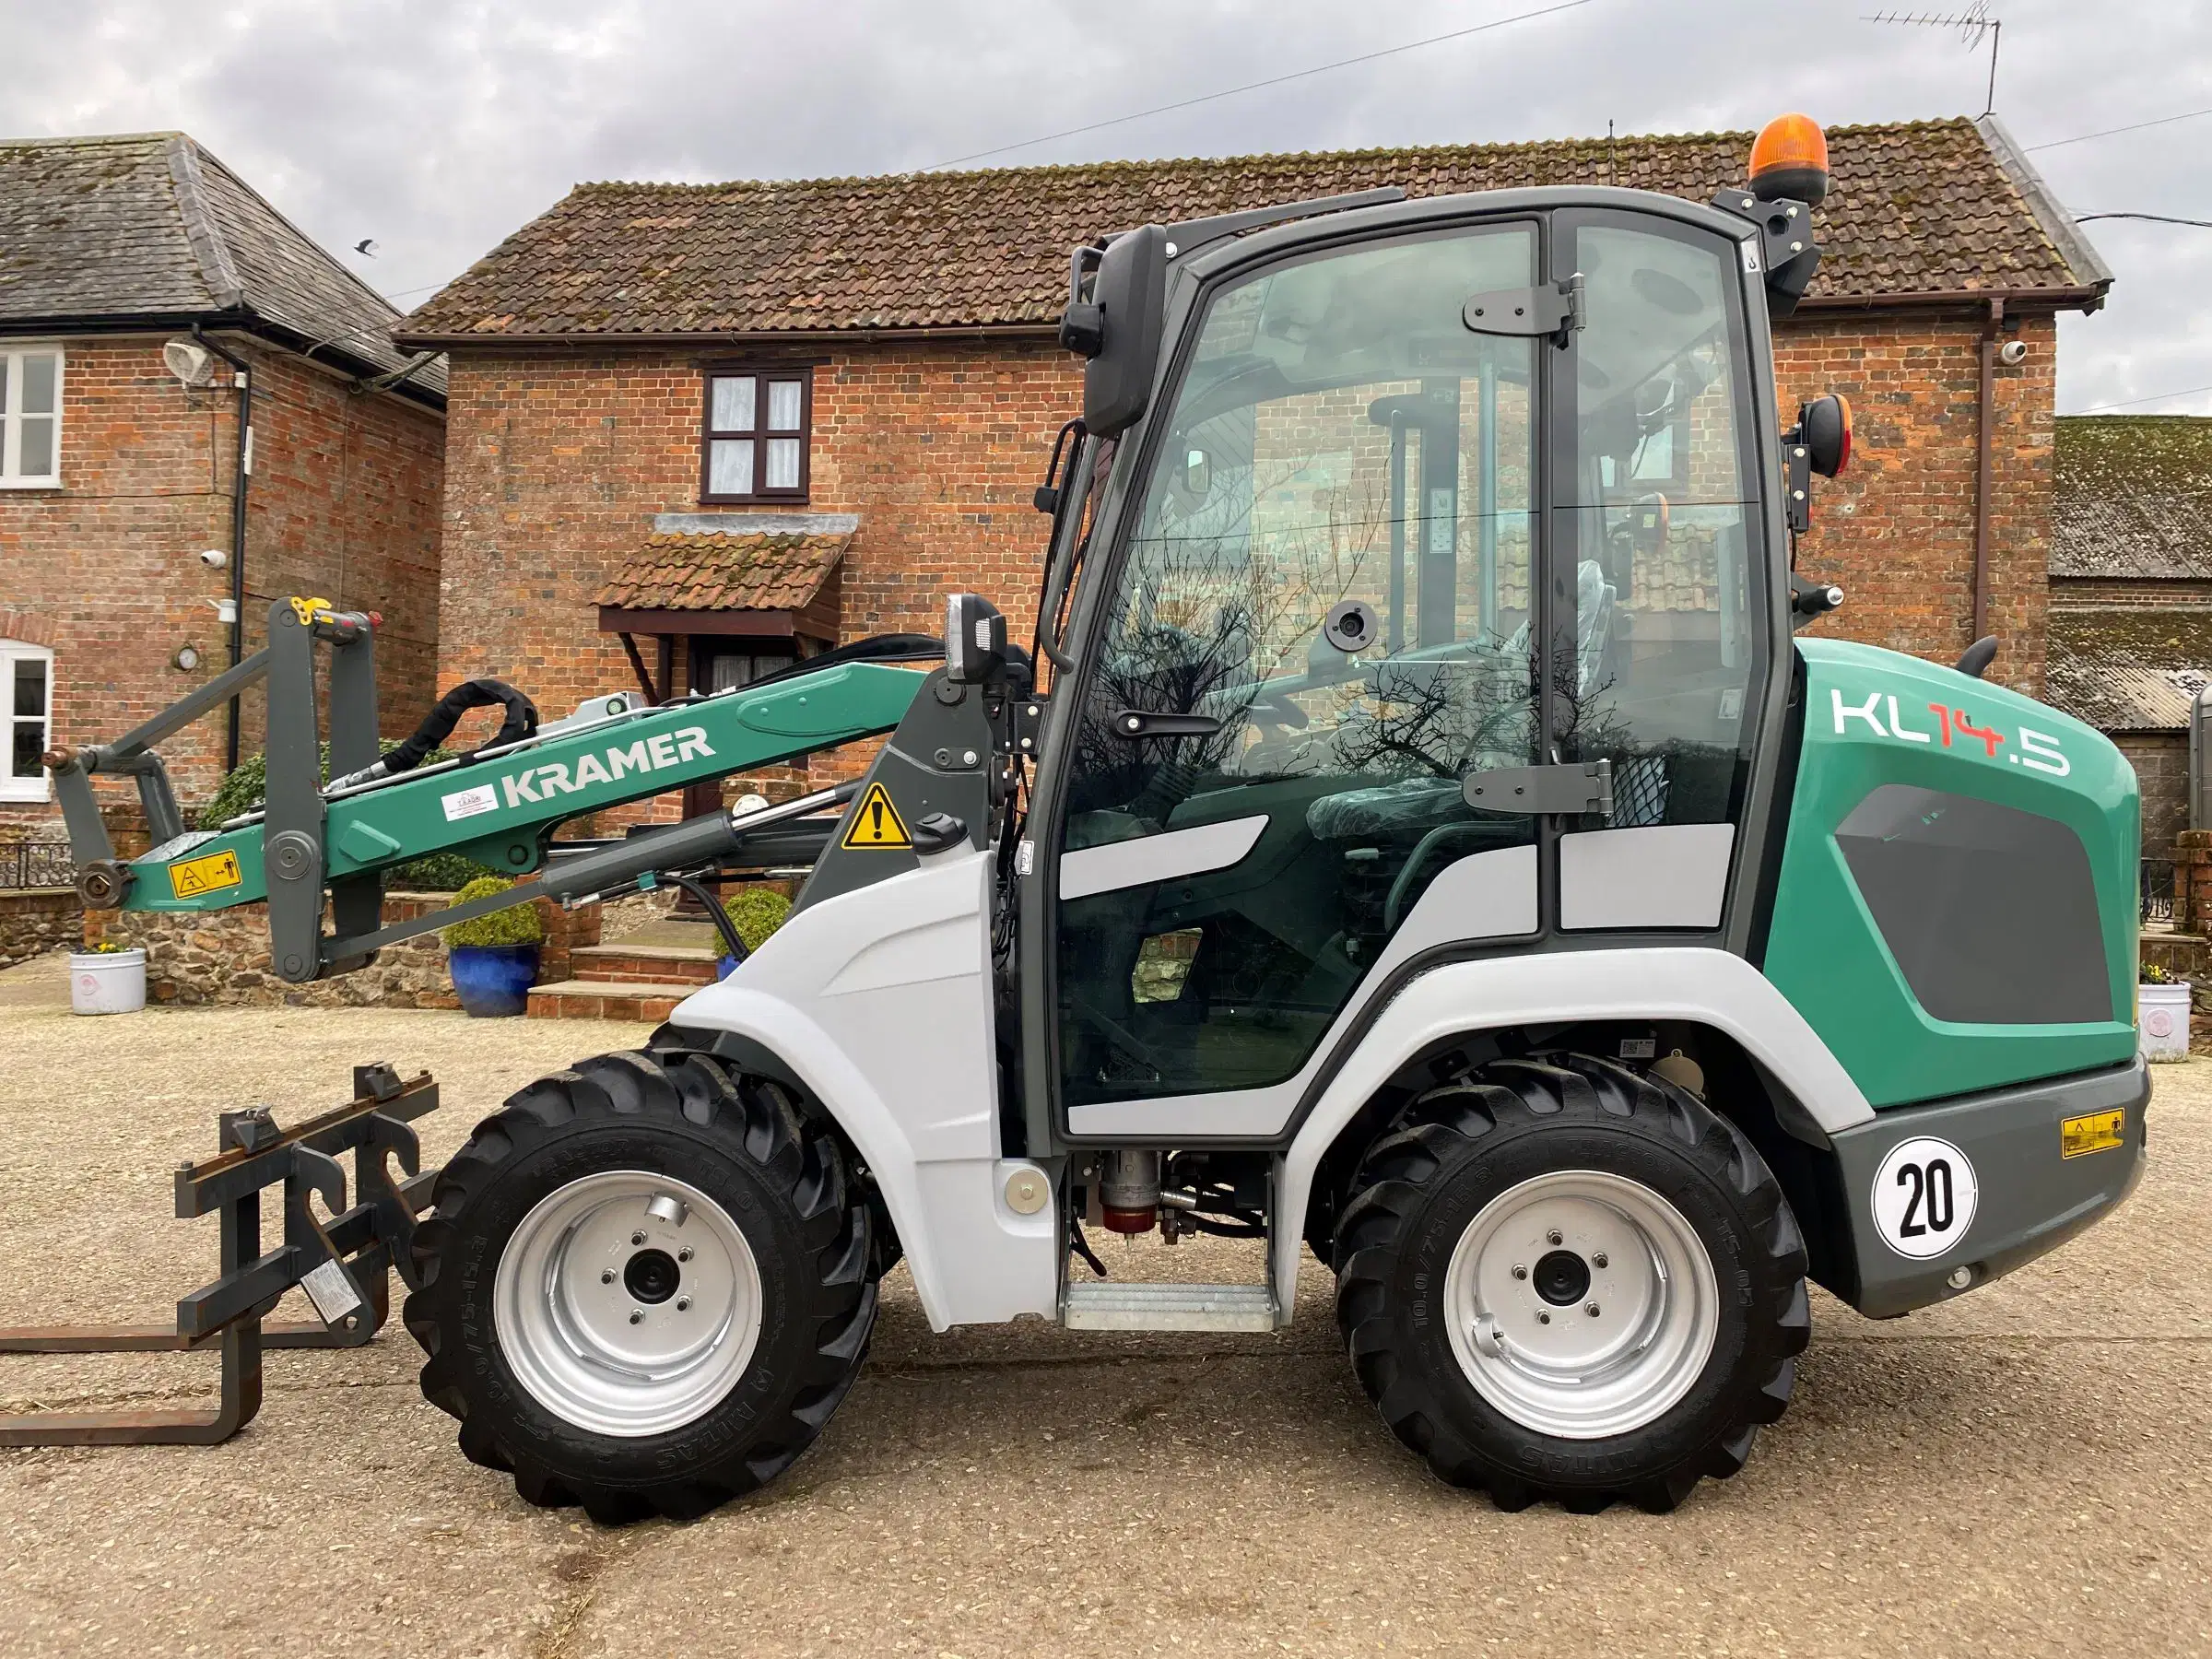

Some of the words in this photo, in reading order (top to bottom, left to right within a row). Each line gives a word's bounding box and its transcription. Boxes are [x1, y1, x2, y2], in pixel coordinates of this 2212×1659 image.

[500, 726, 716, 808] KRAMER
[1830, 688, 2071, 777] KL14.5
[1897, 1159, 1954, 1239] 20
[1520, 1446, 1637, 1475] MITAS
